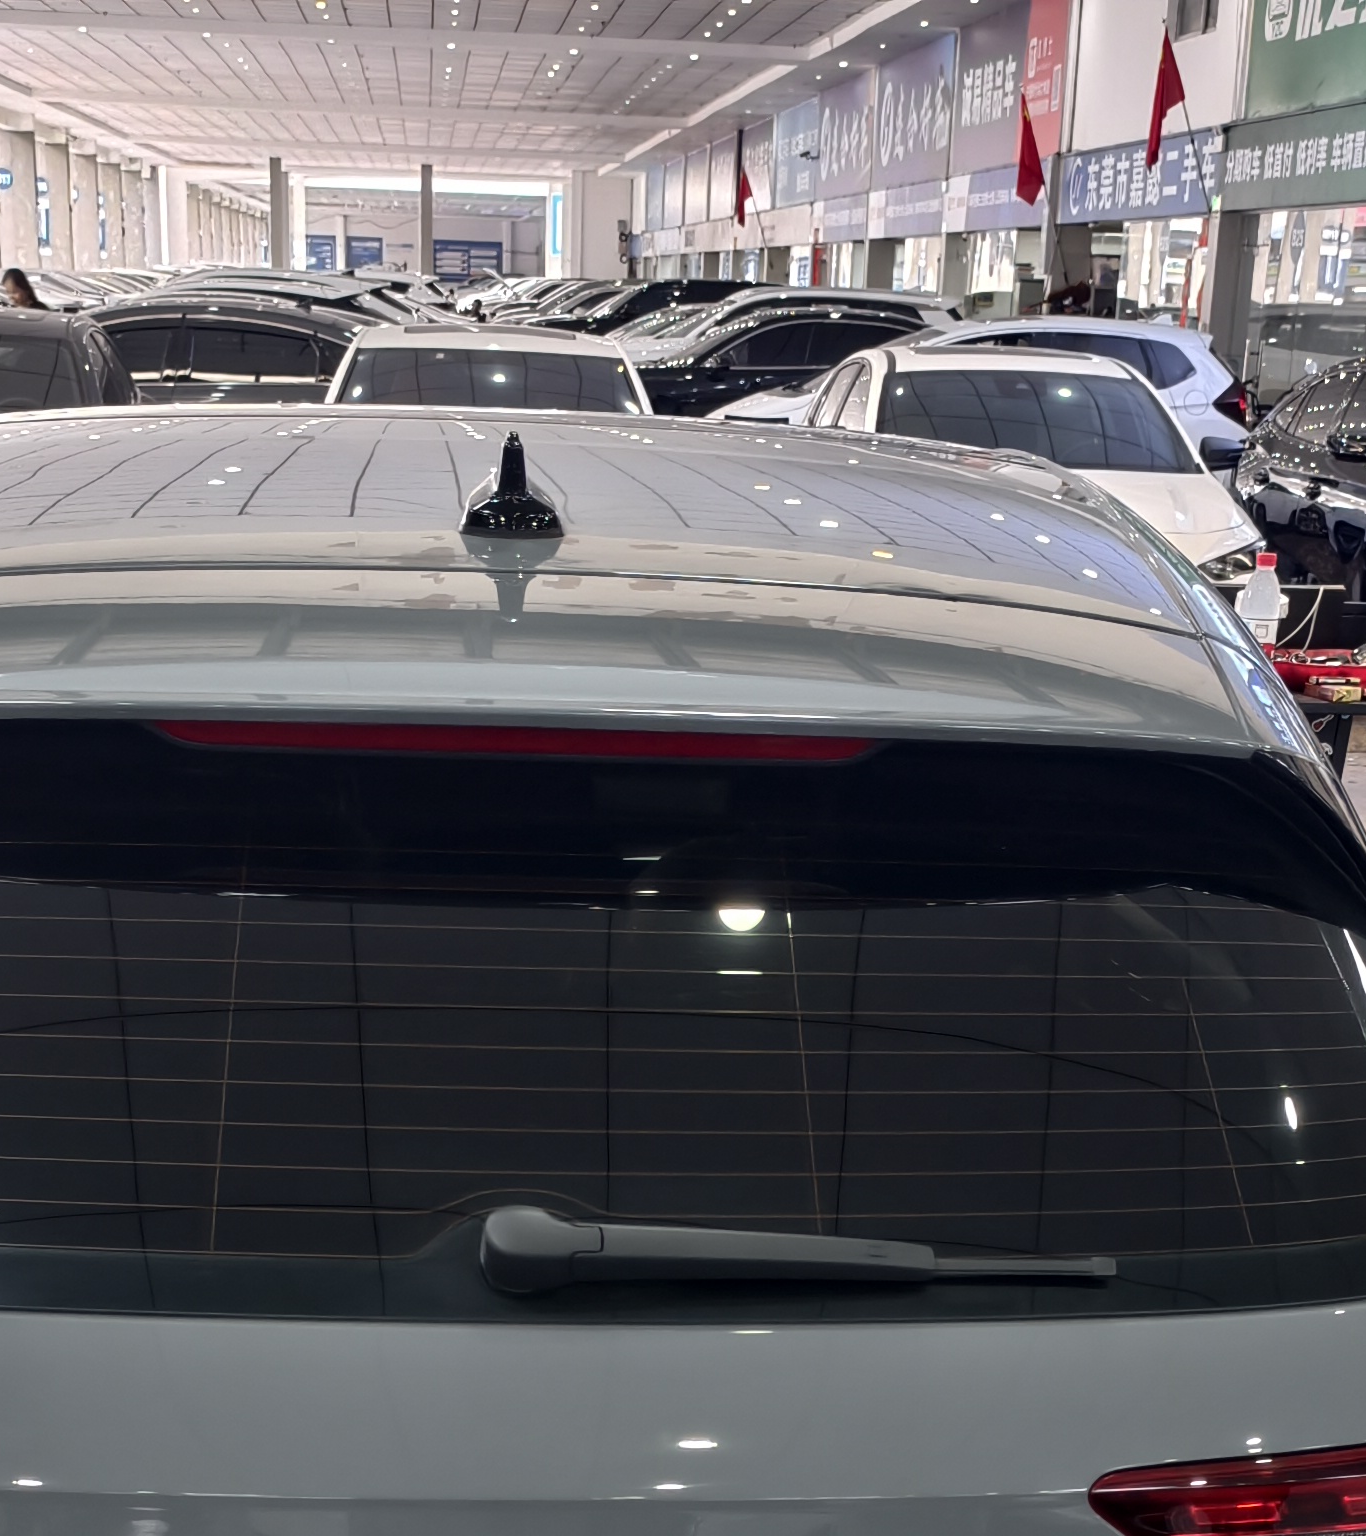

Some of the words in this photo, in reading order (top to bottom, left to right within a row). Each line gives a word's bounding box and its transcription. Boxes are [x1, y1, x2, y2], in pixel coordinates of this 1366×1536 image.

[1224, 145, 1262, 184] 分期购车
[1263, 140, 1294, 181] 低首付
[1295, 135, 1328, 177] 低利率
